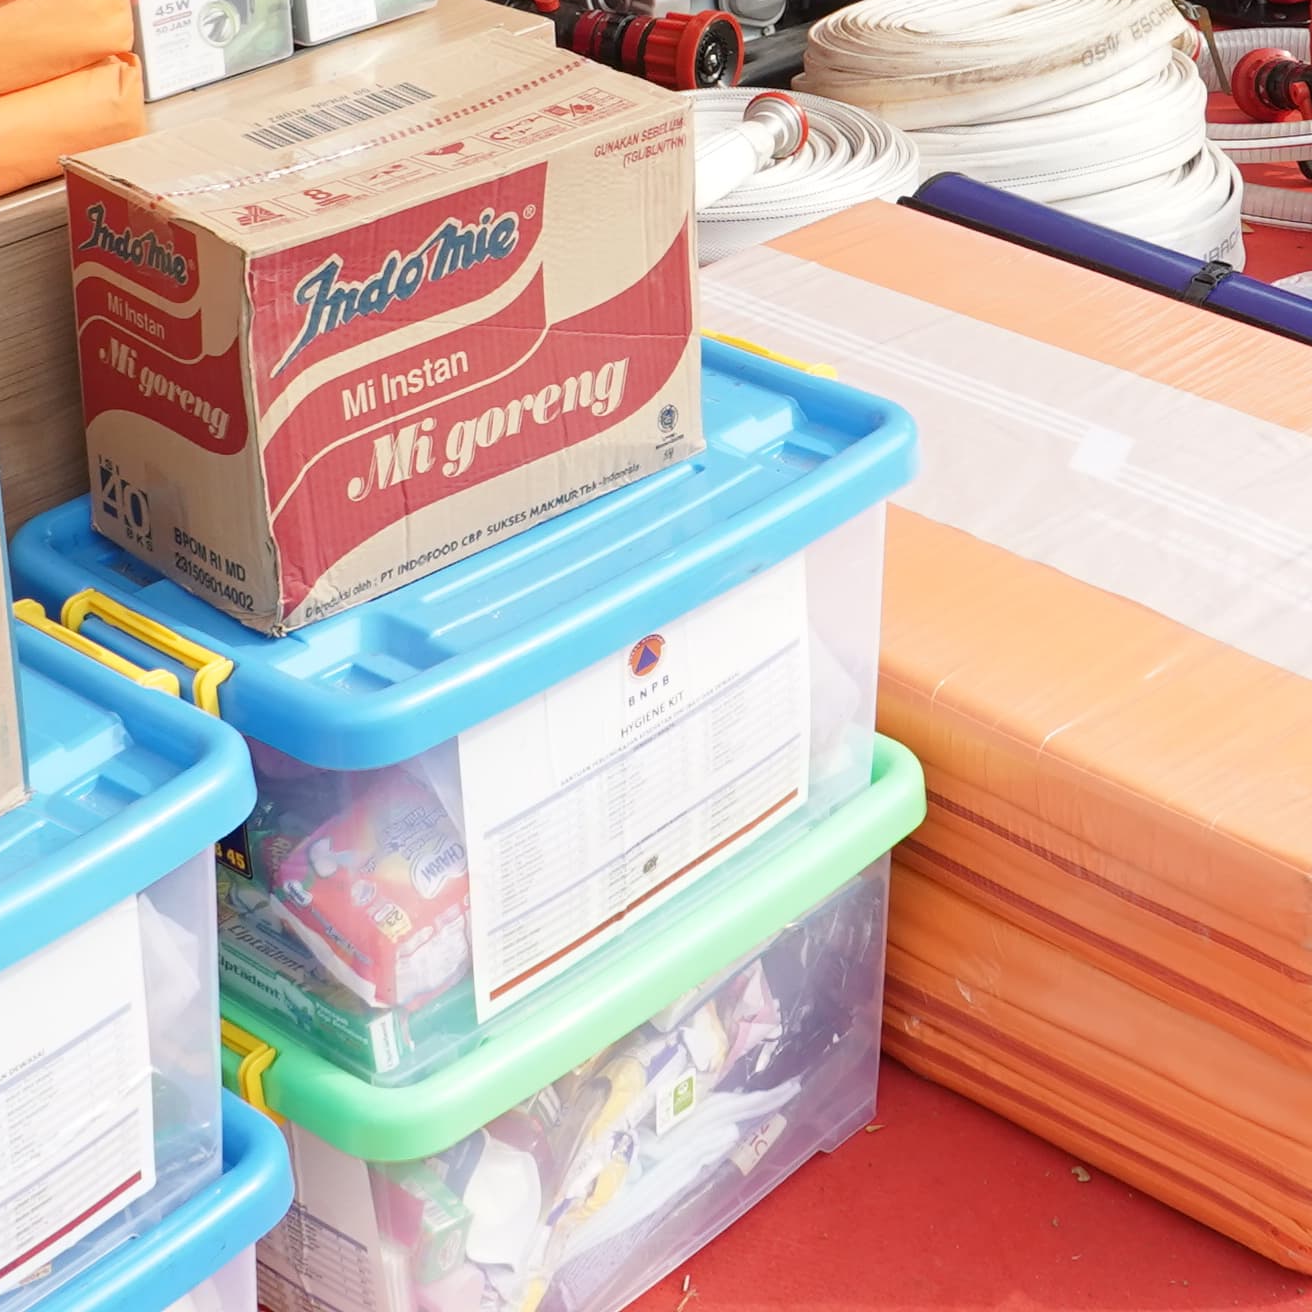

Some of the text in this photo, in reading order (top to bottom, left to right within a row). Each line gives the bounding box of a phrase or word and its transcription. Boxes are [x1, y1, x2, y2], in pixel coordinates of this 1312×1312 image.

[1131, 2, 1177, 39] ESCH
[594, 133, 641, 159] GUNAKAN
[107, 291, 166, 339] Mi Instan
[98, 336, 231, 441] Mi goreng
[341, 349, 469, 421] Mi Instan
[347, 357, 631, 502] Mi goreng
[100, 465, 152, 538] 40
[174, 527, 247, 582] BPOM RI MD
[380, 566, 394, 584] PT
[461, 529, 484, 548] CBP
[486, 510, 527, 537] SUKSES
[529, 489, 579, 520] MAKMUR
[619, 703, 666, 740] HYGIENE
[667, 690, 686, 707] KIT
[226, 848, 247, 870] 45
[420, 843, 465, 884] CHARM
